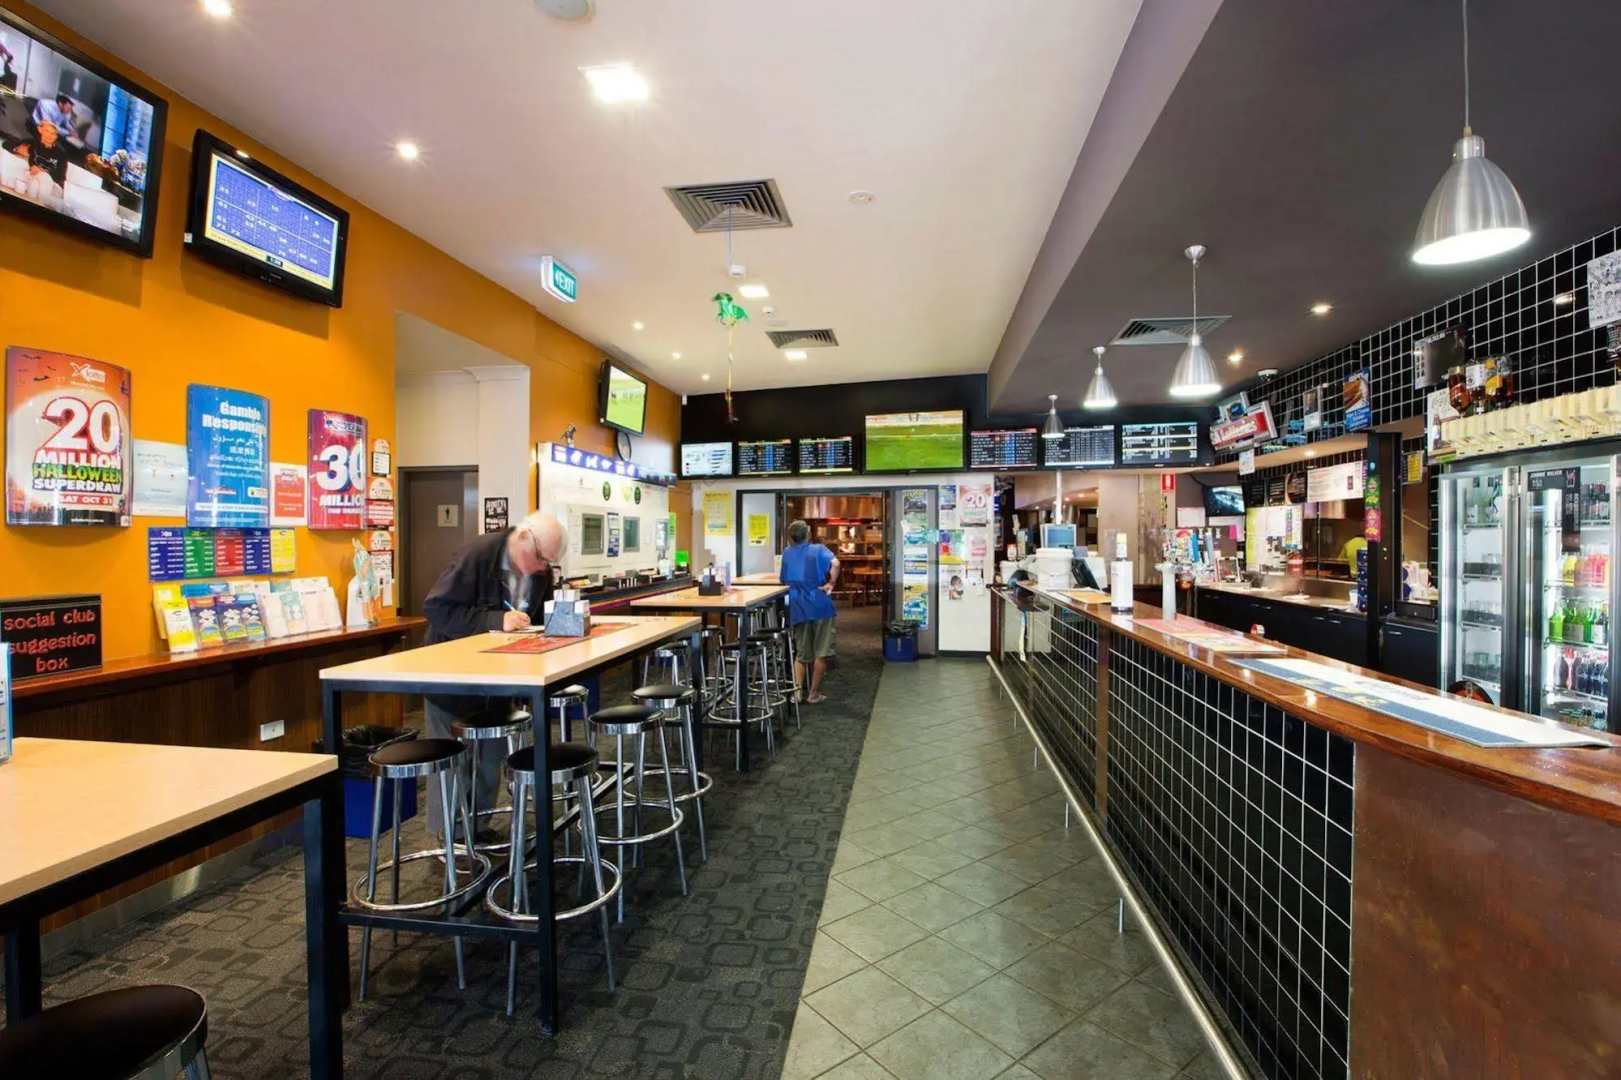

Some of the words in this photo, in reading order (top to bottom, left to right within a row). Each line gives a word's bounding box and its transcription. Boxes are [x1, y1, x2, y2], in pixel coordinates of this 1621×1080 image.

[559, 271, 574, 295] EXIT
[220, 401, 261, 420] Gamble
[43, 396, 121, 454] 20
[35, 450, 122, 469] MILLION
[33, 463, 123, 482] HALLOWEEN
[33, 478, 123, 494] SUPERDRAW
[60, 495, 78, 503] SAT
[319, 494, 363, 507] MILLIO
[966, 493, 987, 507] 20
[3, 610, 55, 631] social
[63, 608, 96, 624] club
[9, 632, 96, 655] suggestion
[36, 657, 69, 673] box
